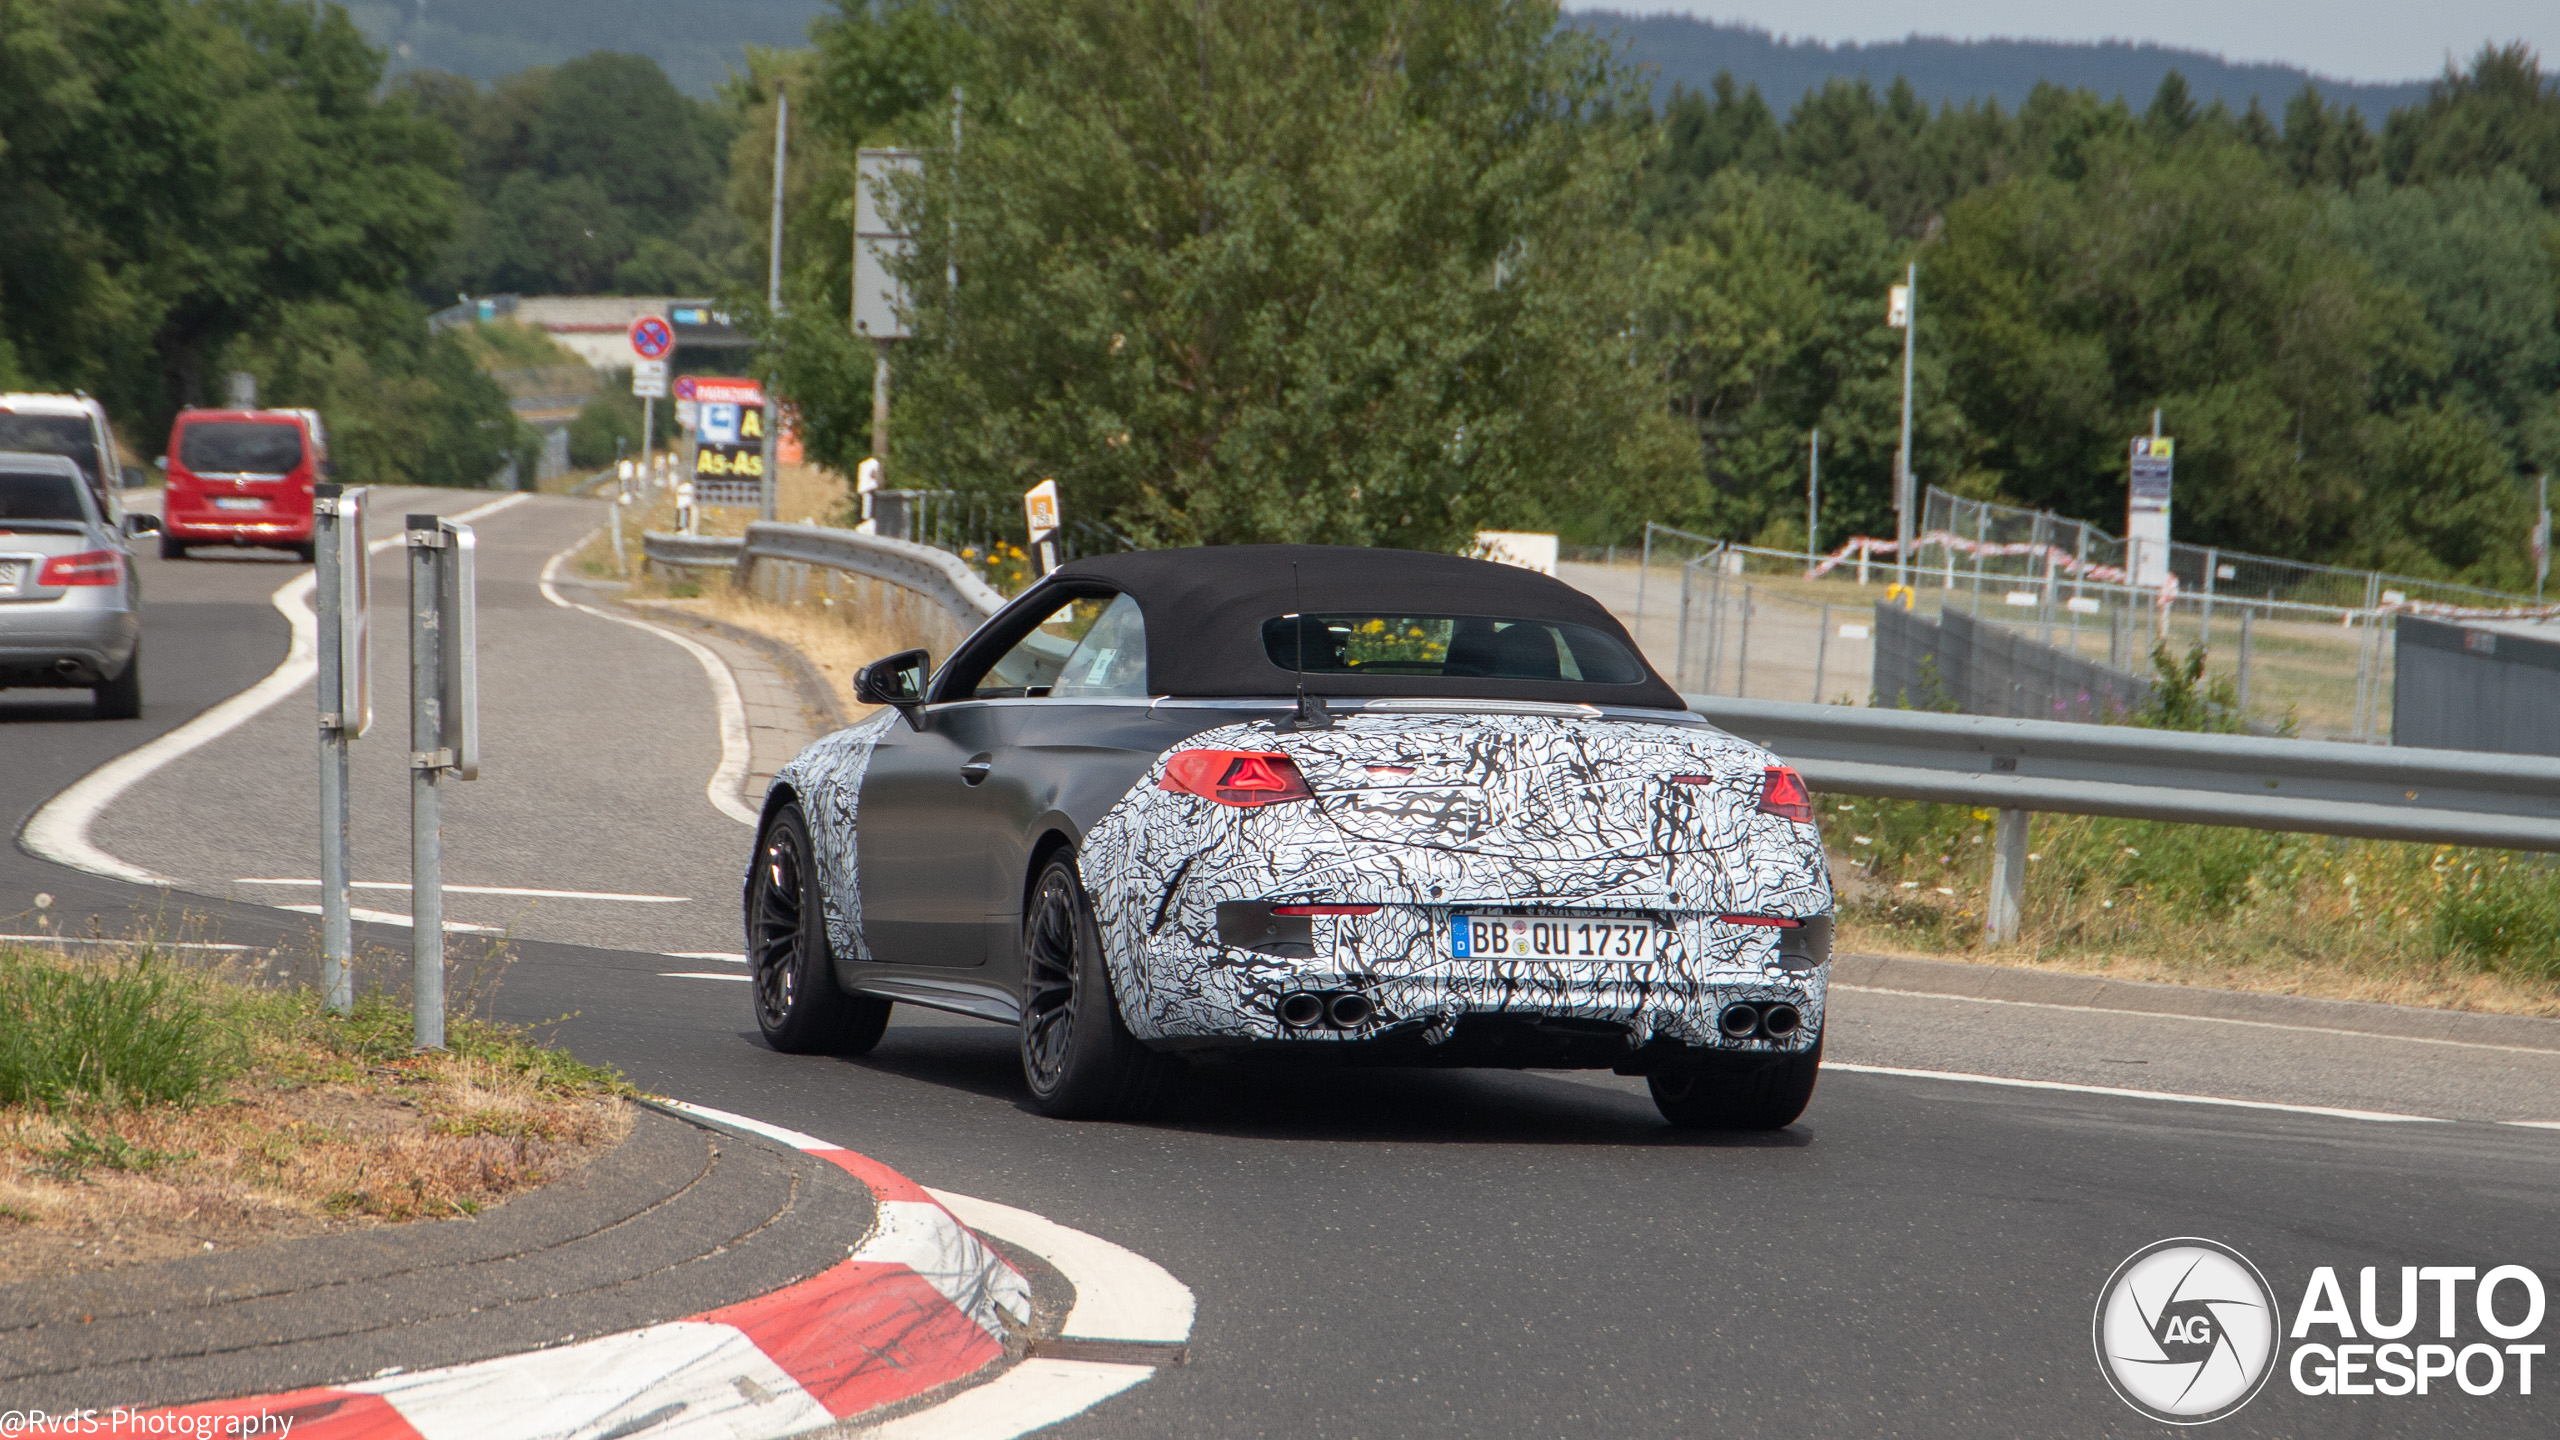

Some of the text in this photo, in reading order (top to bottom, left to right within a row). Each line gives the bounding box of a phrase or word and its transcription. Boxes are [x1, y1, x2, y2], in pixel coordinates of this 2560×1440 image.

[1457, 941, 1465, 950] D
[1473, 922, 1648, 956] BB QU 1737
